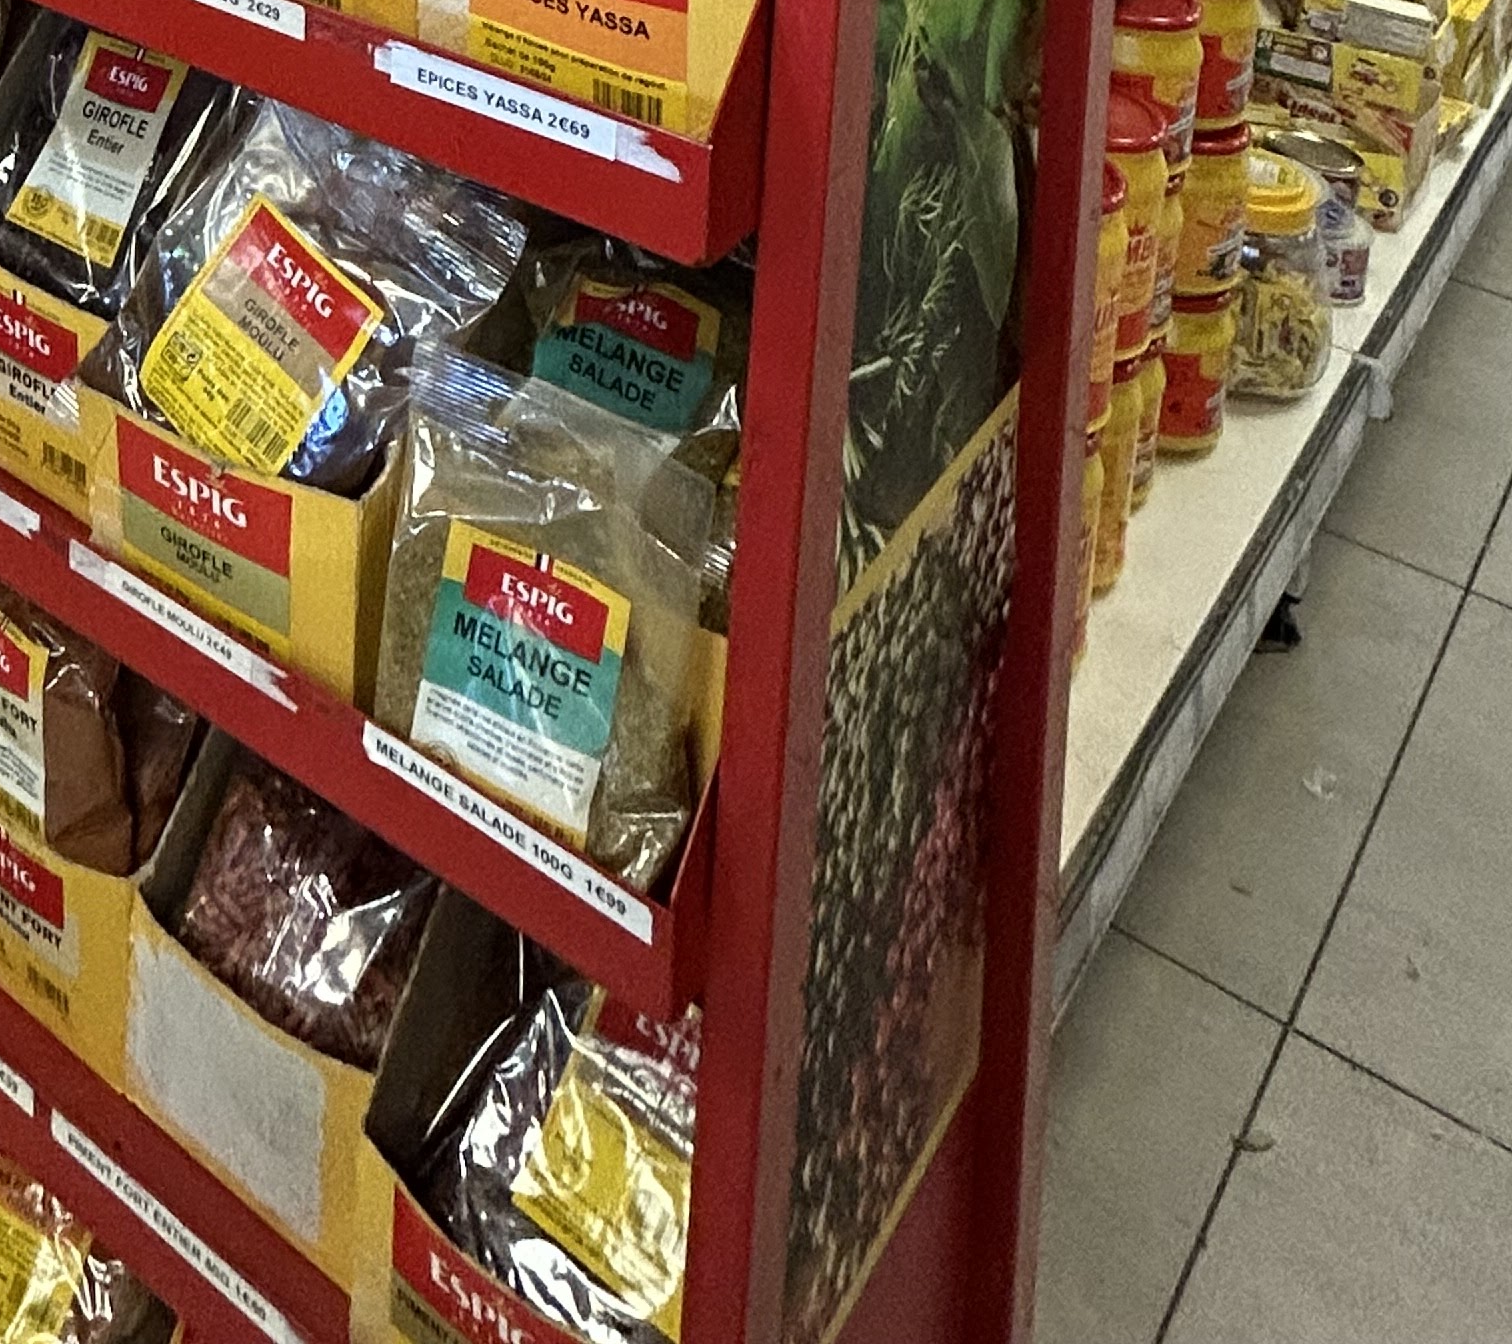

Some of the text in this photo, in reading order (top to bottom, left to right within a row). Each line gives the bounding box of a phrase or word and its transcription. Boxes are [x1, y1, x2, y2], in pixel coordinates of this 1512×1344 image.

[575, 0, 651, 41] YASSA
[107, 65, 149, 93] ESPIG
[417, 66, 591, 140] EPICES YASSA 2€69
[82, 99, 150, 141] GIROFLE
[86, 127, 127, 157] Entier
[266, 241, 333, 321] ESPIG
[236, 313, 284, 363] MOULU
[243, 296, 302, 356] GIROFLE
[554, 322, 686, 394] MELANGE
[567, 351, 656, 412] SALADE
[152, 452, 248, 530] ESPIG
[159, 523, 234, 581] GIROFLE
[120, 578, 206, 643] GIROFLE MOULU
[501, 572, 576, 627] ESPIG
[452, 609, 594, 696] MELANGE
[0, 692, 39, 734] FORT
[466, 654, 564, 721] SALADE
[375, 735, 455, 802] MELANGE
[458, 787, 528, 849] SALADE
[531, 840, 574, 883] 100G
[583, 871, 629, 918] 1€99
